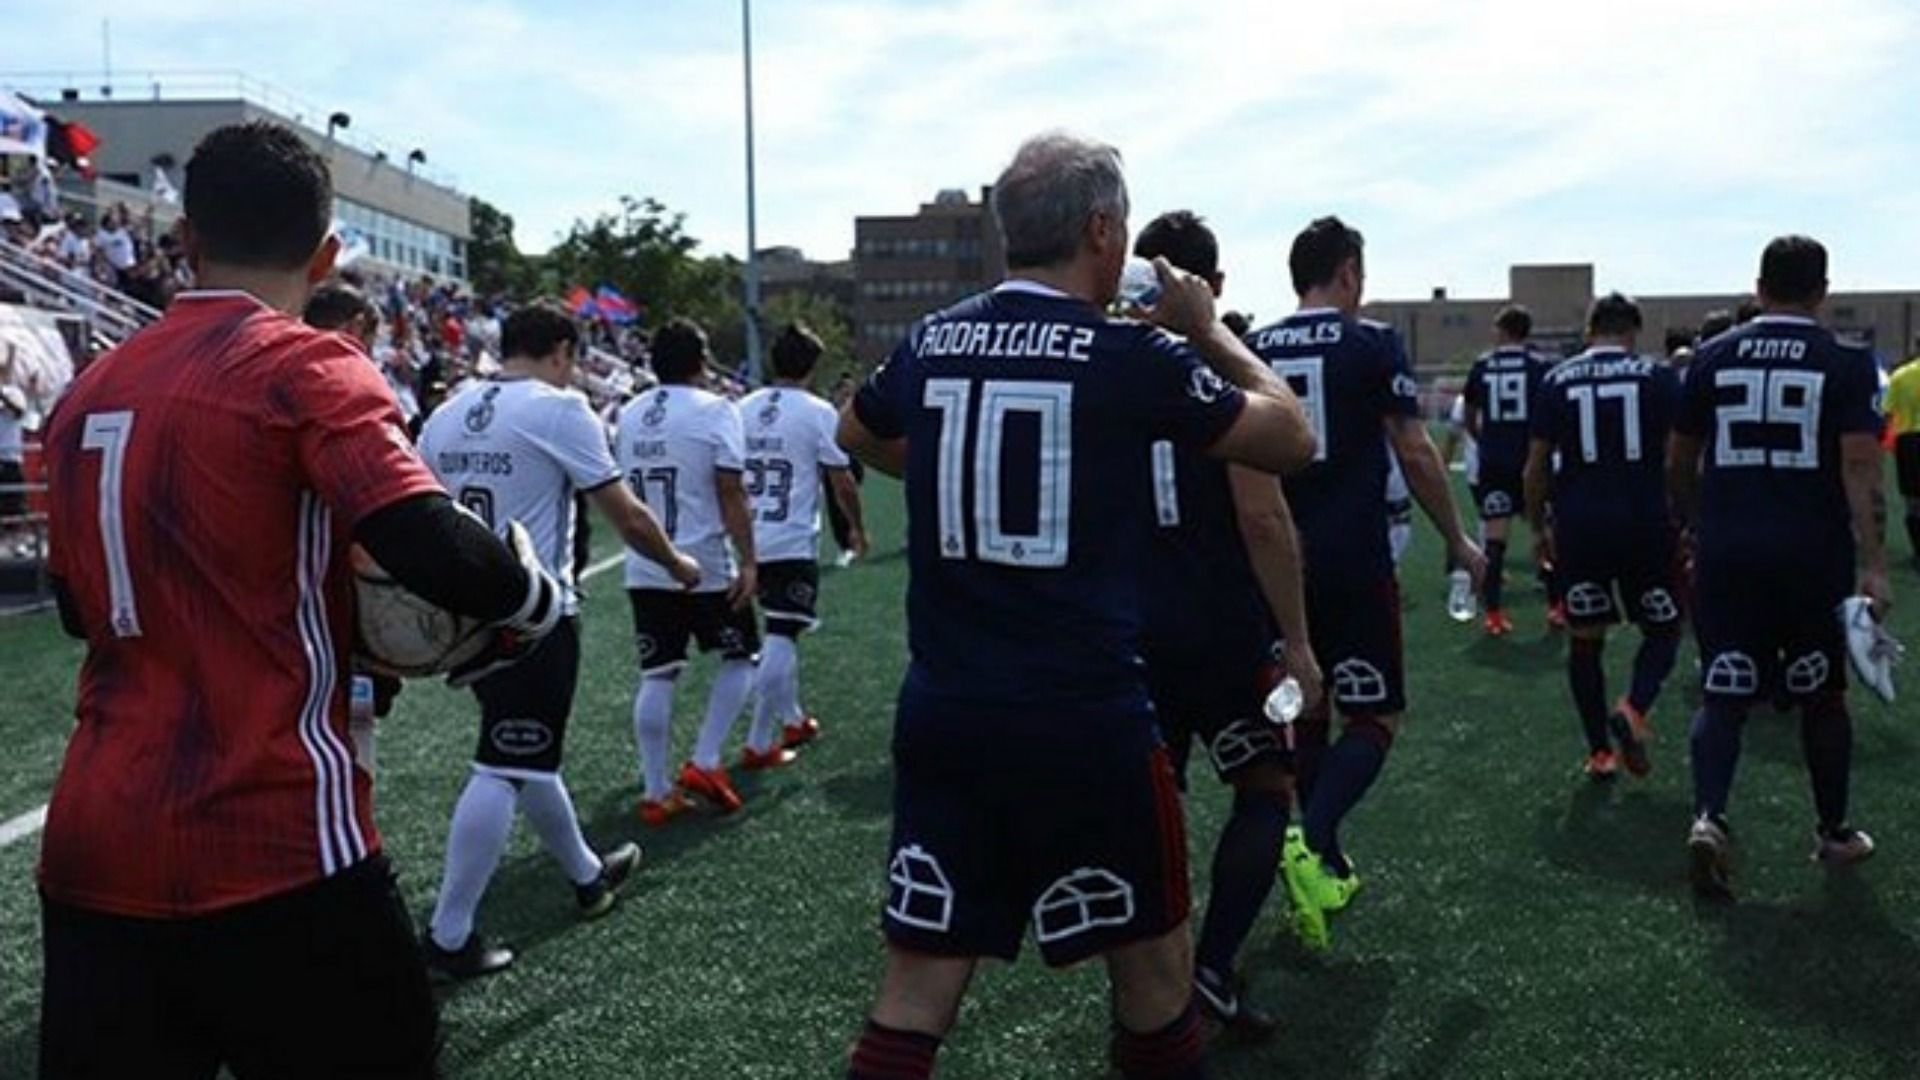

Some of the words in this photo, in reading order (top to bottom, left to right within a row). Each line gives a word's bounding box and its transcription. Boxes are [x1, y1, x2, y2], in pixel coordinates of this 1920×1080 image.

[916, 320, 1095, 362] RODRIGUEZ
[1256, 322, 1342, 350] CANALES
[1737, 337, 1807, 360] PINTO
[1482, 372, 1528, 422] 19
[1715, 369, 1825, 470] 29
[1567, 381, 1643, 464] 17
[923, 377, 1074, 569] 10
